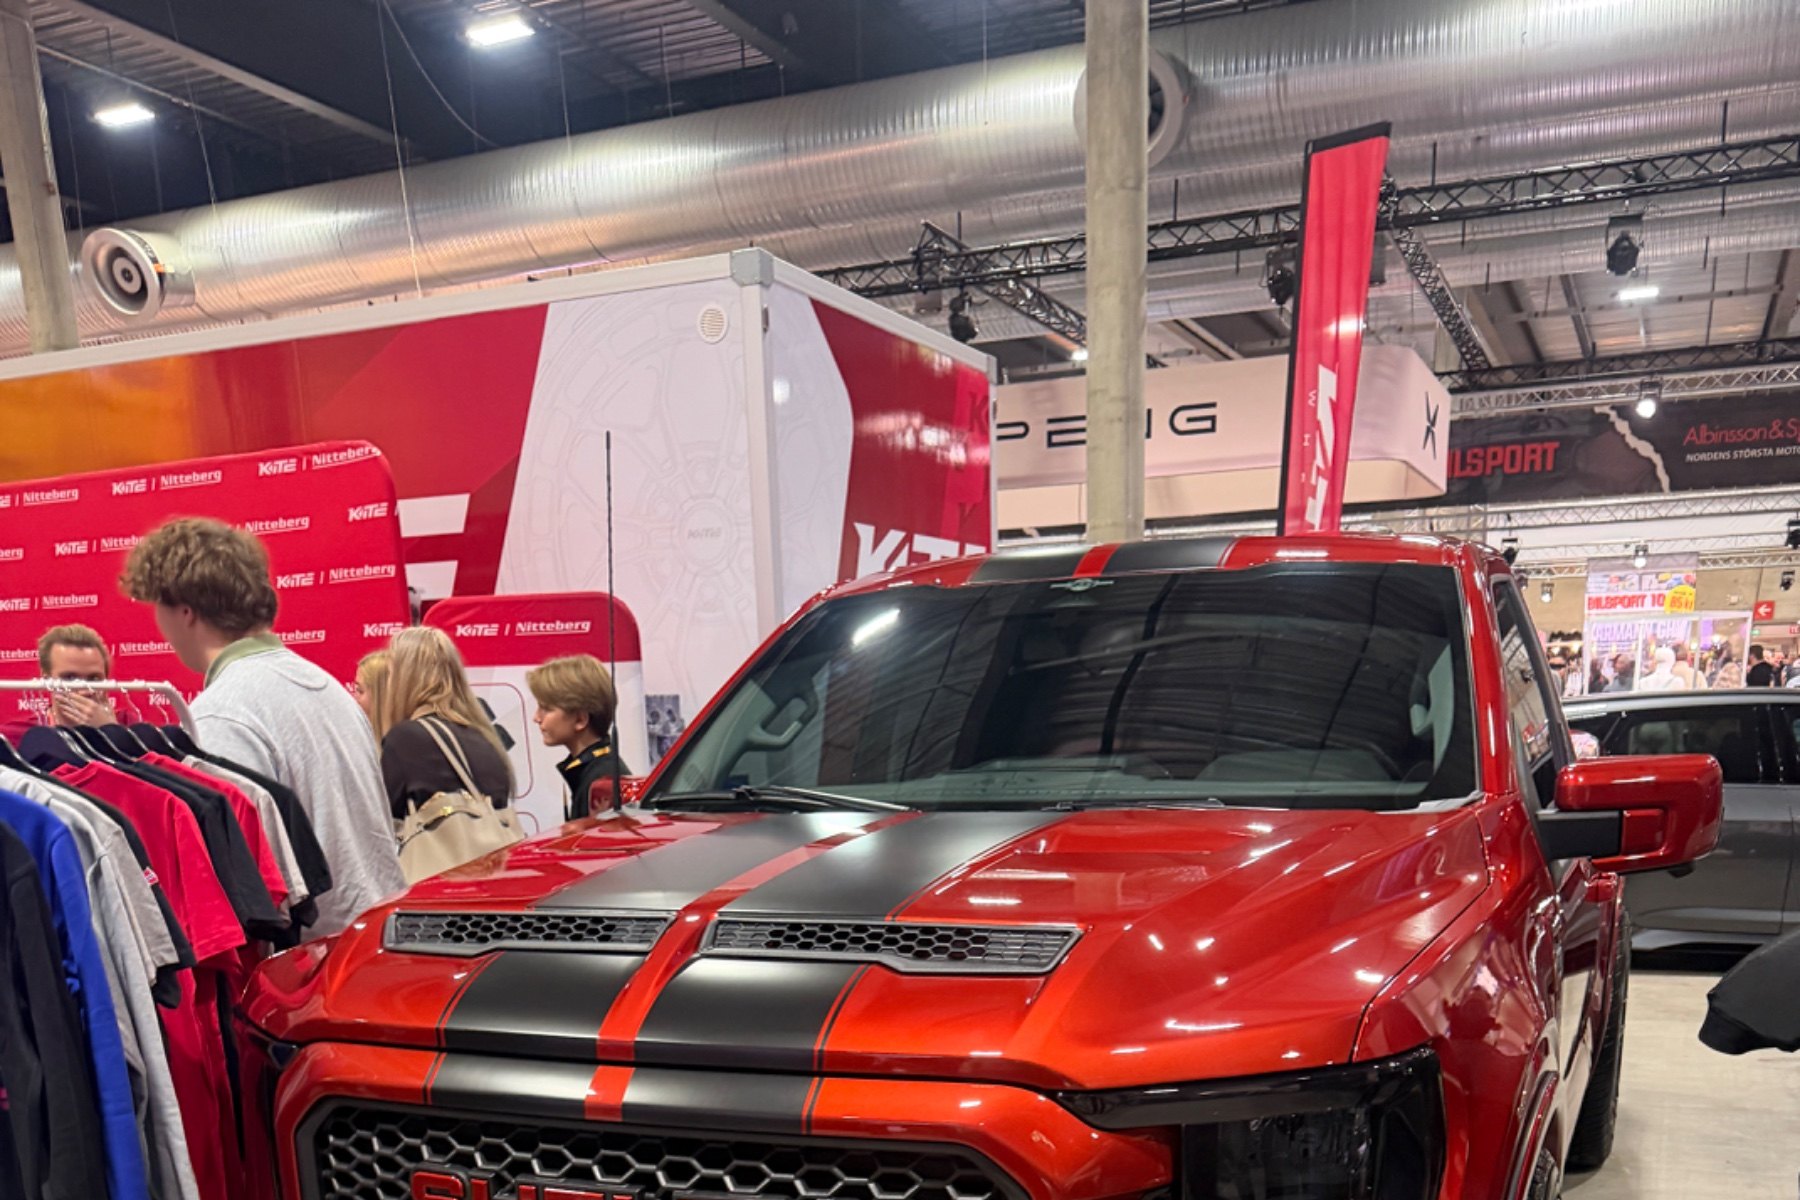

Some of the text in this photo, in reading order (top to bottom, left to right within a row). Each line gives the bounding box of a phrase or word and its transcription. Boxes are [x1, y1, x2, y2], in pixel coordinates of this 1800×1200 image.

[1447, 441, 1560, 479] ILSPORT
[1685, 451, 1731, 462] NORDENS
[160, 470, 222, 490] Nitteberg
[23, 489, 79, 506] Nitteberg
[329, 564, 396, 584] Nitteberg
[43, 594, 98, 609] Nitteberg
[515, 620, 591, 636] Nitteberg
[276, 630, 326, 645] tteberg
